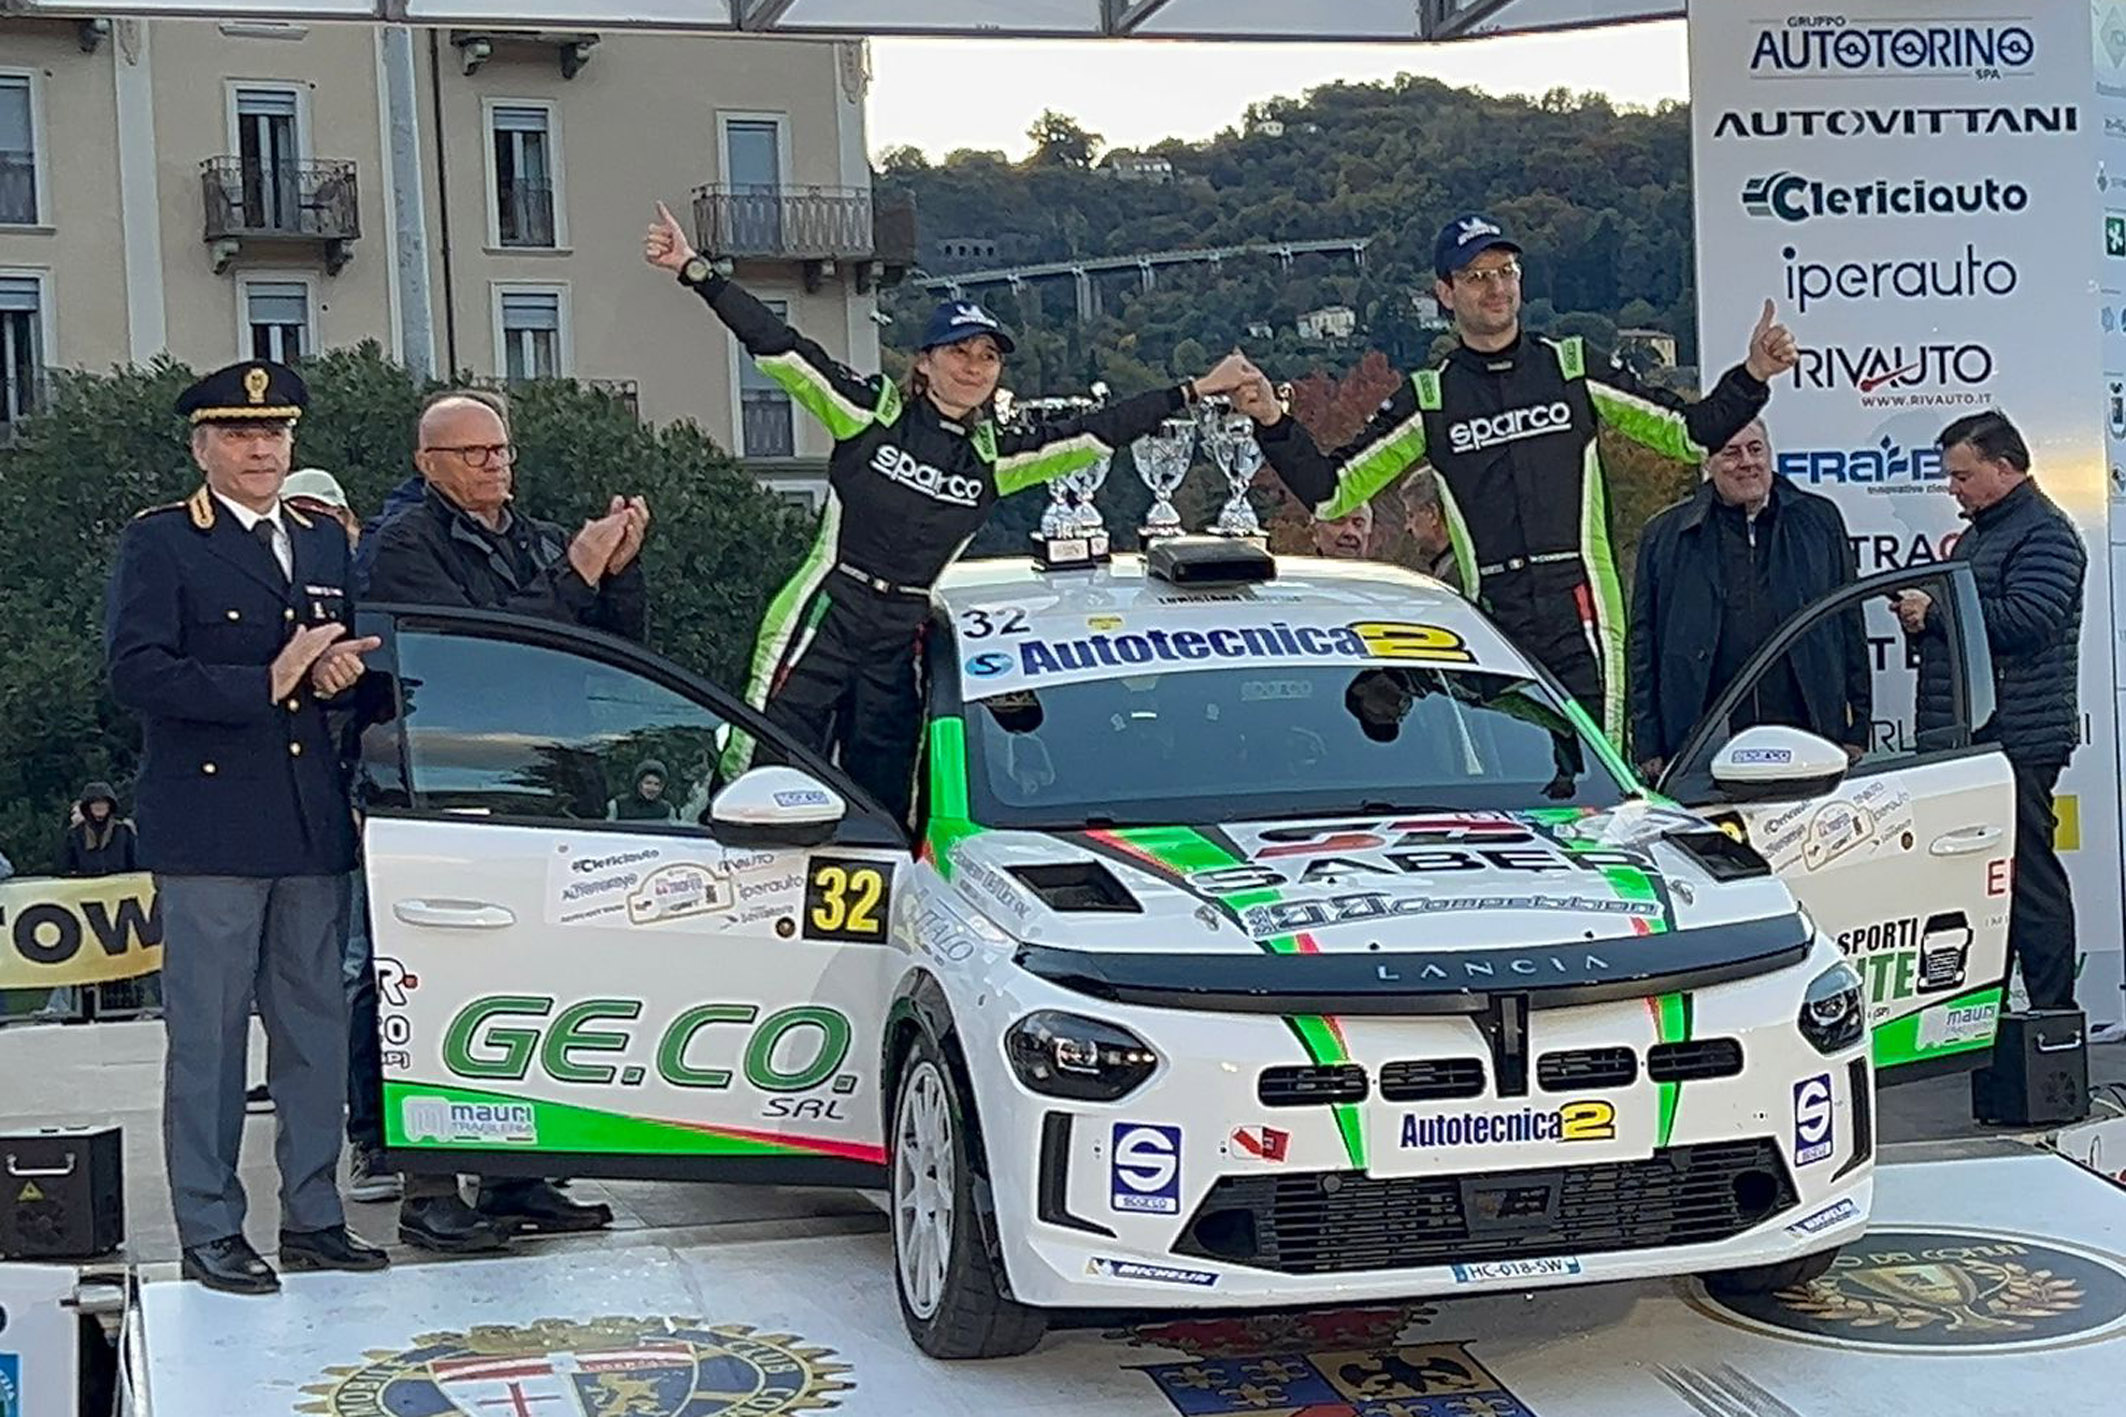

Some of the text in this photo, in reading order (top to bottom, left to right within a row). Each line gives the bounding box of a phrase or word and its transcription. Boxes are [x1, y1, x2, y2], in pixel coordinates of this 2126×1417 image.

[1787, 16, 1846, 27] GRUPPO
[1750, 27, 2034, 69] AUTOTORINO
[1975, 69, 2001, 80] SPA
[1714, 107, 2077, 138] AUTOVITTANI
[1769, 172, 2028, 221] Clericiauto
[1782, 244, 2017, 312] iperauto
[1794, 345, 1992, 390] RIVAUTO
[1862, 394, 1992, 406] WWW.RIVAUTO.IT
[1450, 402, 1571, 450] sparco
[876, 444, 983, 500] sparco
[962, 607, 1032, 640] 32
[812, 866, 880, 934] 32
[1836, 917, 1918, 956] SPORTI
[1377, 953, 1609, 981] LANCIA
[443, 994, 858, 1094] GE.CO.
[451, 1105, 531, 1122] mauri
[762, 1098, 845, 1120] SRL
[1119, 1264, 1212, 1283] MICHELIN
